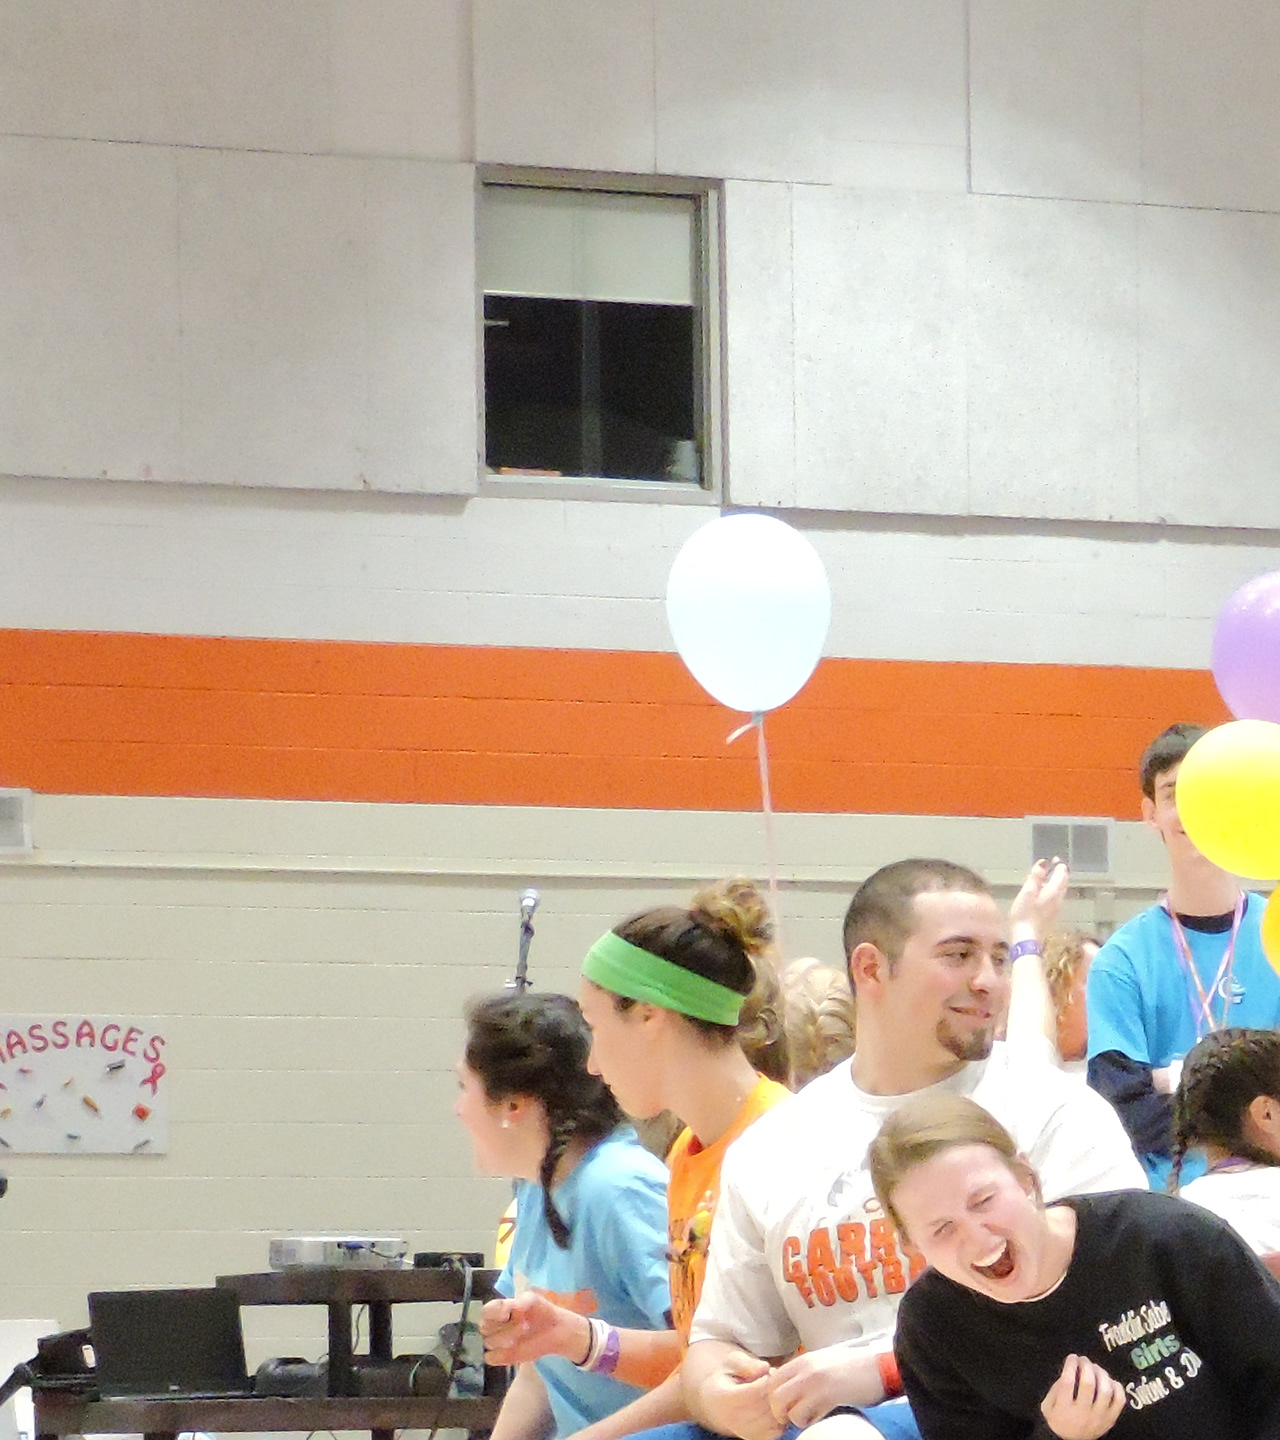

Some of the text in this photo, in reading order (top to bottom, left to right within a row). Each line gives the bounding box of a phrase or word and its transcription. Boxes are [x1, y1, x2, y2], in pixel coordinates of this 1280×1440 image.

[782, 1218, 898, 1283] CARR
[793, 1252, 926, 1308] FOOTB
[1130, 1333, 1181, 1370] Girls
[1125, 1375, 1170, 1410] Swim
[1164, 1366, 1185, 1389] &
